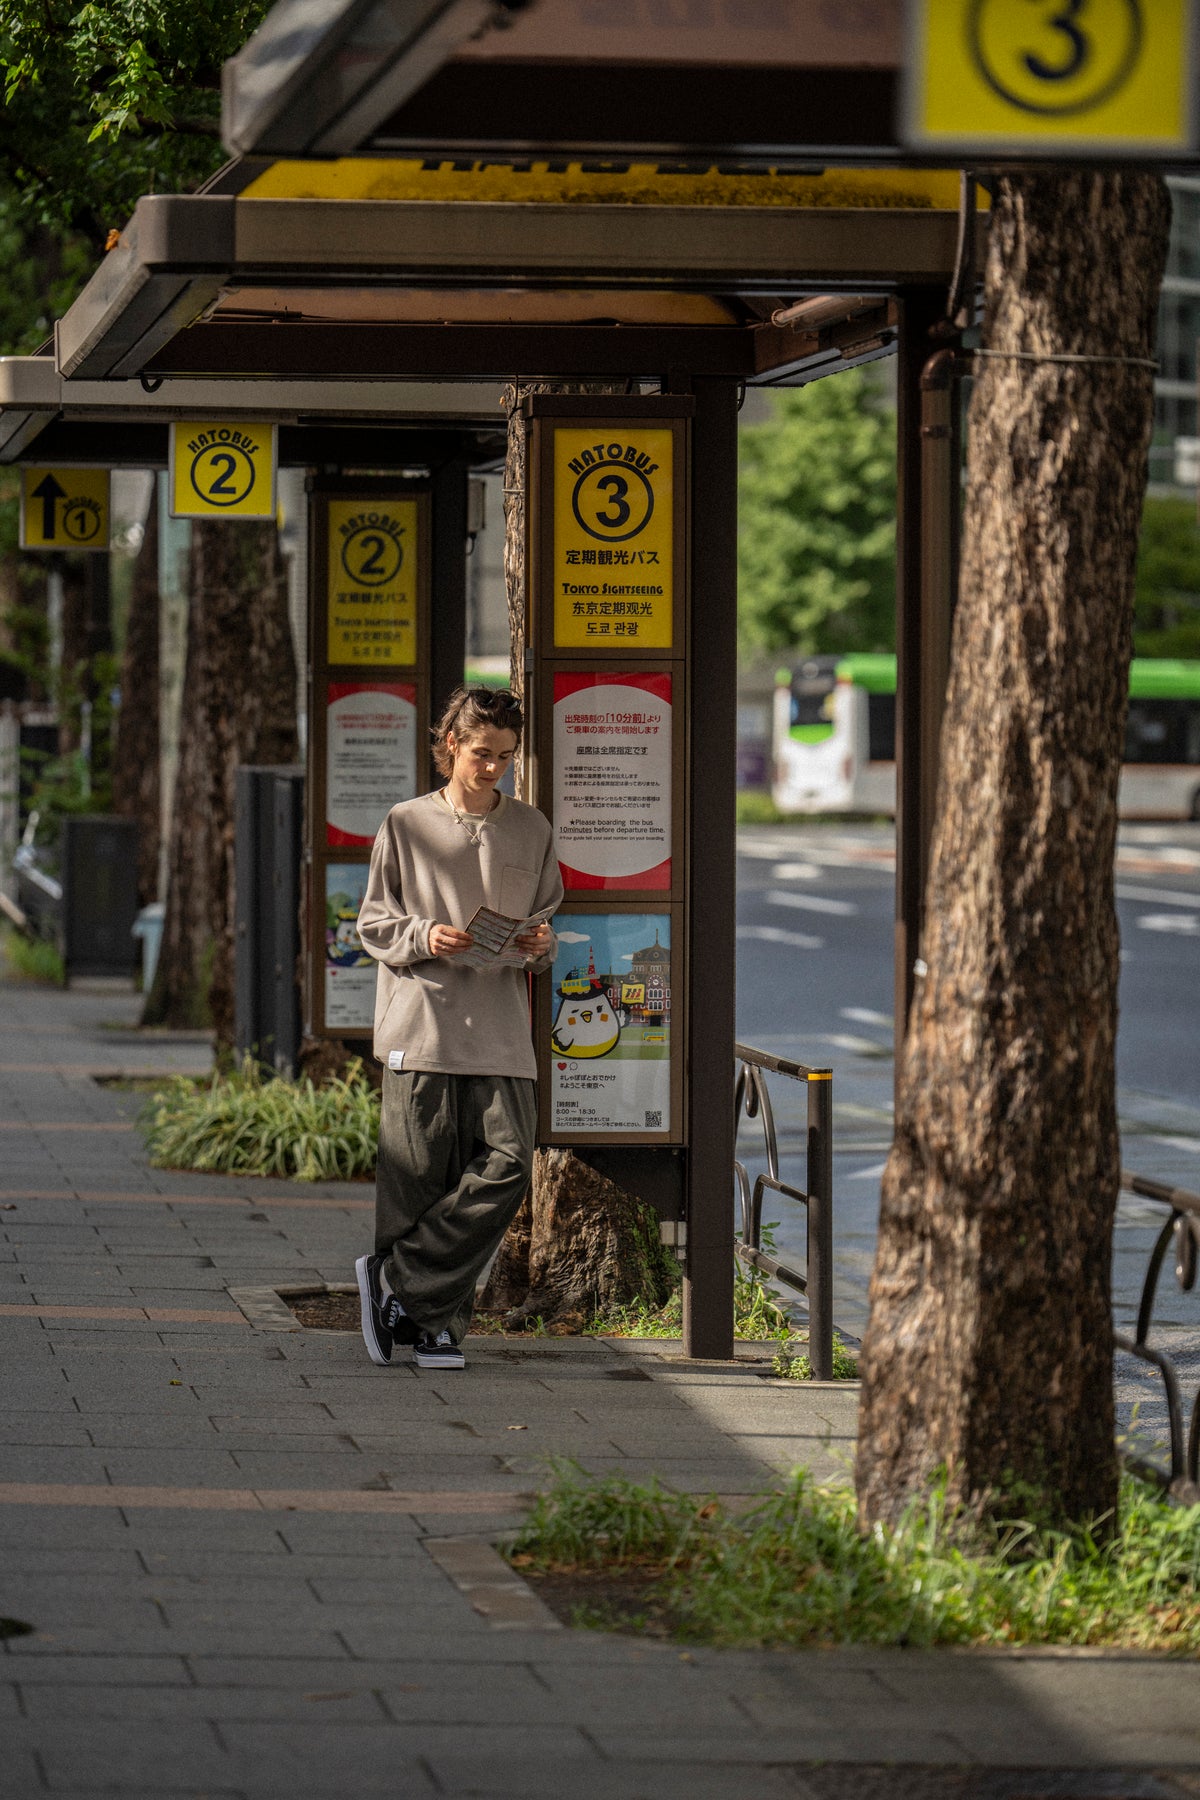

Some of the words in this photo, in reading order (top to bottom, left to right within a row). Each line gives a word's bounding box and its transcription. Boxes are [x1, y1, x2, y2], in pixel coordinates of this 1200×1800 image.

[1021, 0, 1087, 82] 3
[187, 428, 260, 454] HATOBUS
[567, 443, 660, 477] HATOBUS
[208, 453, 237, 494] 2
[595, 474, 631, 528] 3
[74, 511, 86, 534] 1
[360, 535, 385, 575] 2
[565, 549, 660, 565] 定期観光バス
[562, 582, 600, 595] TOKYO
[572, 601, 653, 615] 东京定期观光
[586, 622, 611, 634] 도쿄
[614, 622, 639, 635] 관광
[559, 826, 593, 834] 10minutes
[593, 826, 615, 834] before
[616, 826, 648, 836] departure
[597, 818, 627, 828] boarding
[629, 818, 641, 826] the
[641, 818, 654, 826] bus
